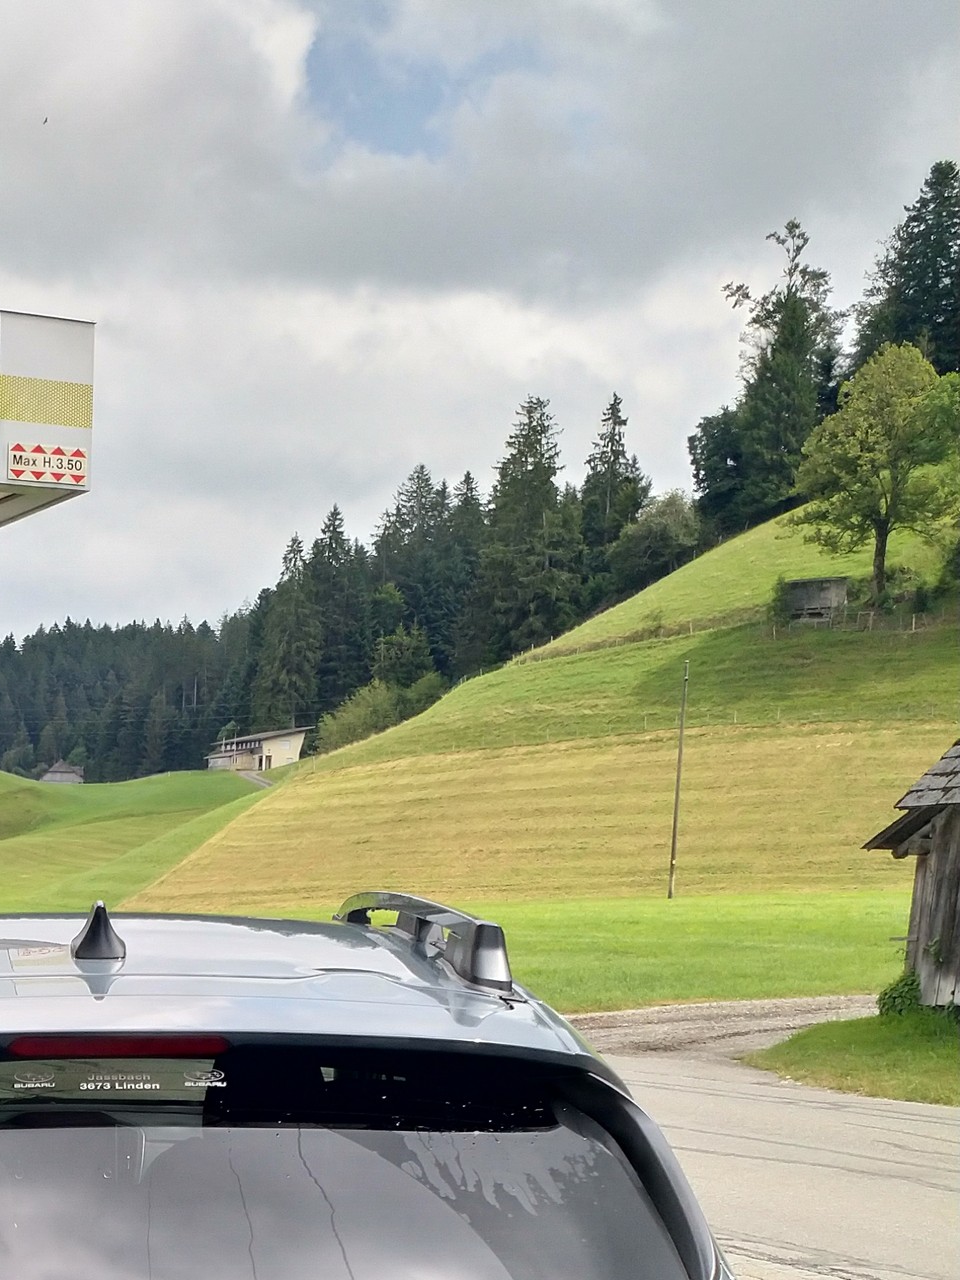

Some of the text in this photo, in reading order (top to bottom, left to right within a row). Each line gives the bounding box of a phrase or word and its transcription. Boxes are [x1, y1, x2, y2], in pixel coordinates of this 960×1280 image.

[12, 454, 38, 467] Max
[87, 1073, 151, 1081] Jassbach
[79, 1082, 160, 1090] 3673 Linden
